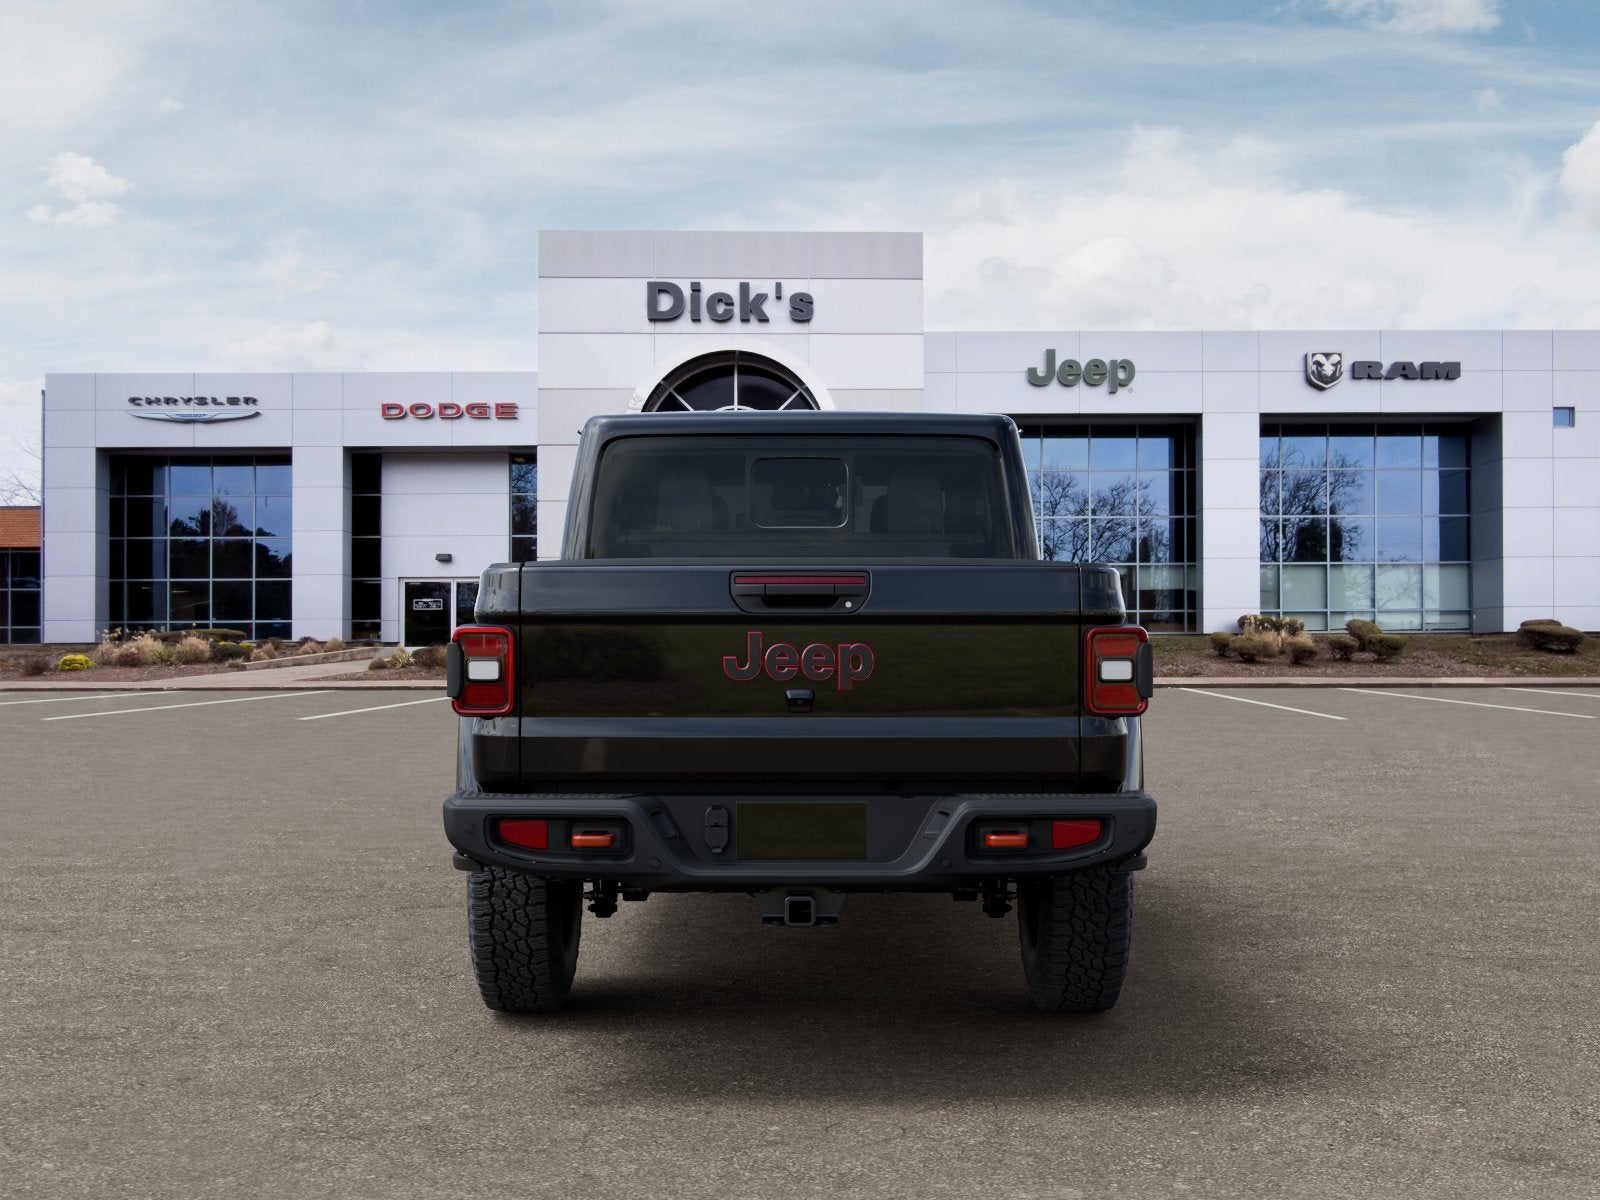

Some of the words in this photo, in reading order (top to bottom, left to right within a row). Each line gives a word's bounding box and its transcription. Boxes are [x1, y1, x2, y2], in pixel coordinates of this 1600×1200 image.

[647, 281, 814, 323] Dick's
[1027, 348, 1136, 394] Jeep
[1352, 360, 1461, 381] RAM
[127, 396, 258, 407] CHRYSLER
[381, 402, 519, 420] DODGE
[722, 631, 875, 691] Jeep
